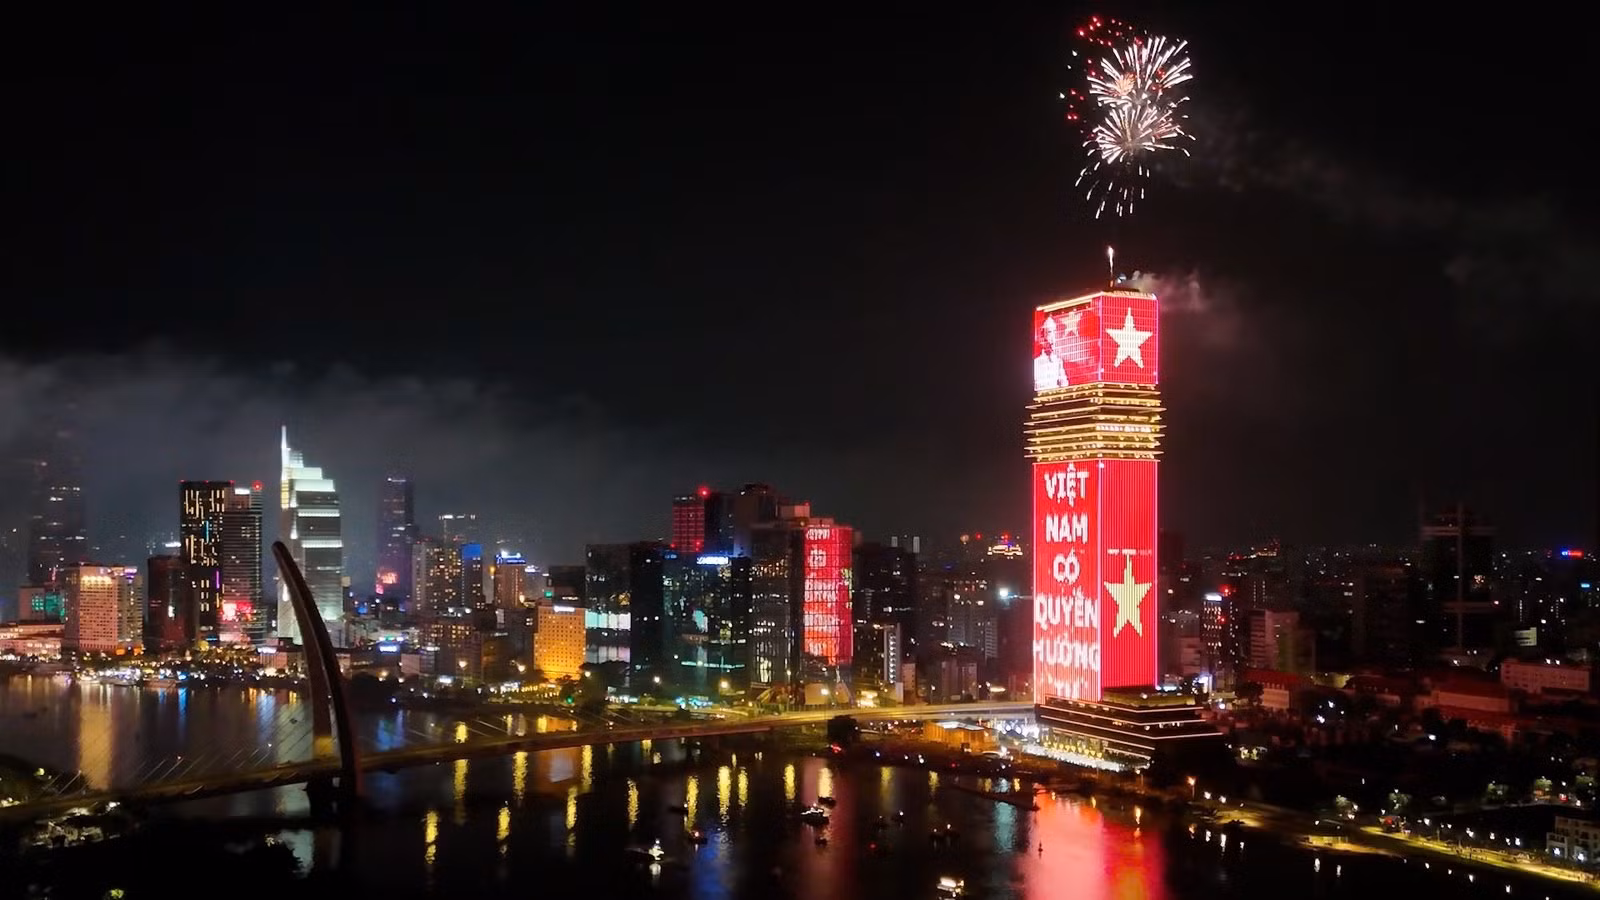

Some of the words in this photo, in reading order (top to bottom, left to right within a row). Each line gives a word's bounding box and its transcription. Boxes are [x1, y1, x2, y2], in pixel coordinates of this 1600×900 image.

[1044, 463, 1089, 507] VIỆT
[1045, 512, 1088, 544] NAM
[1053, 547, 1080, 585] CÓ
